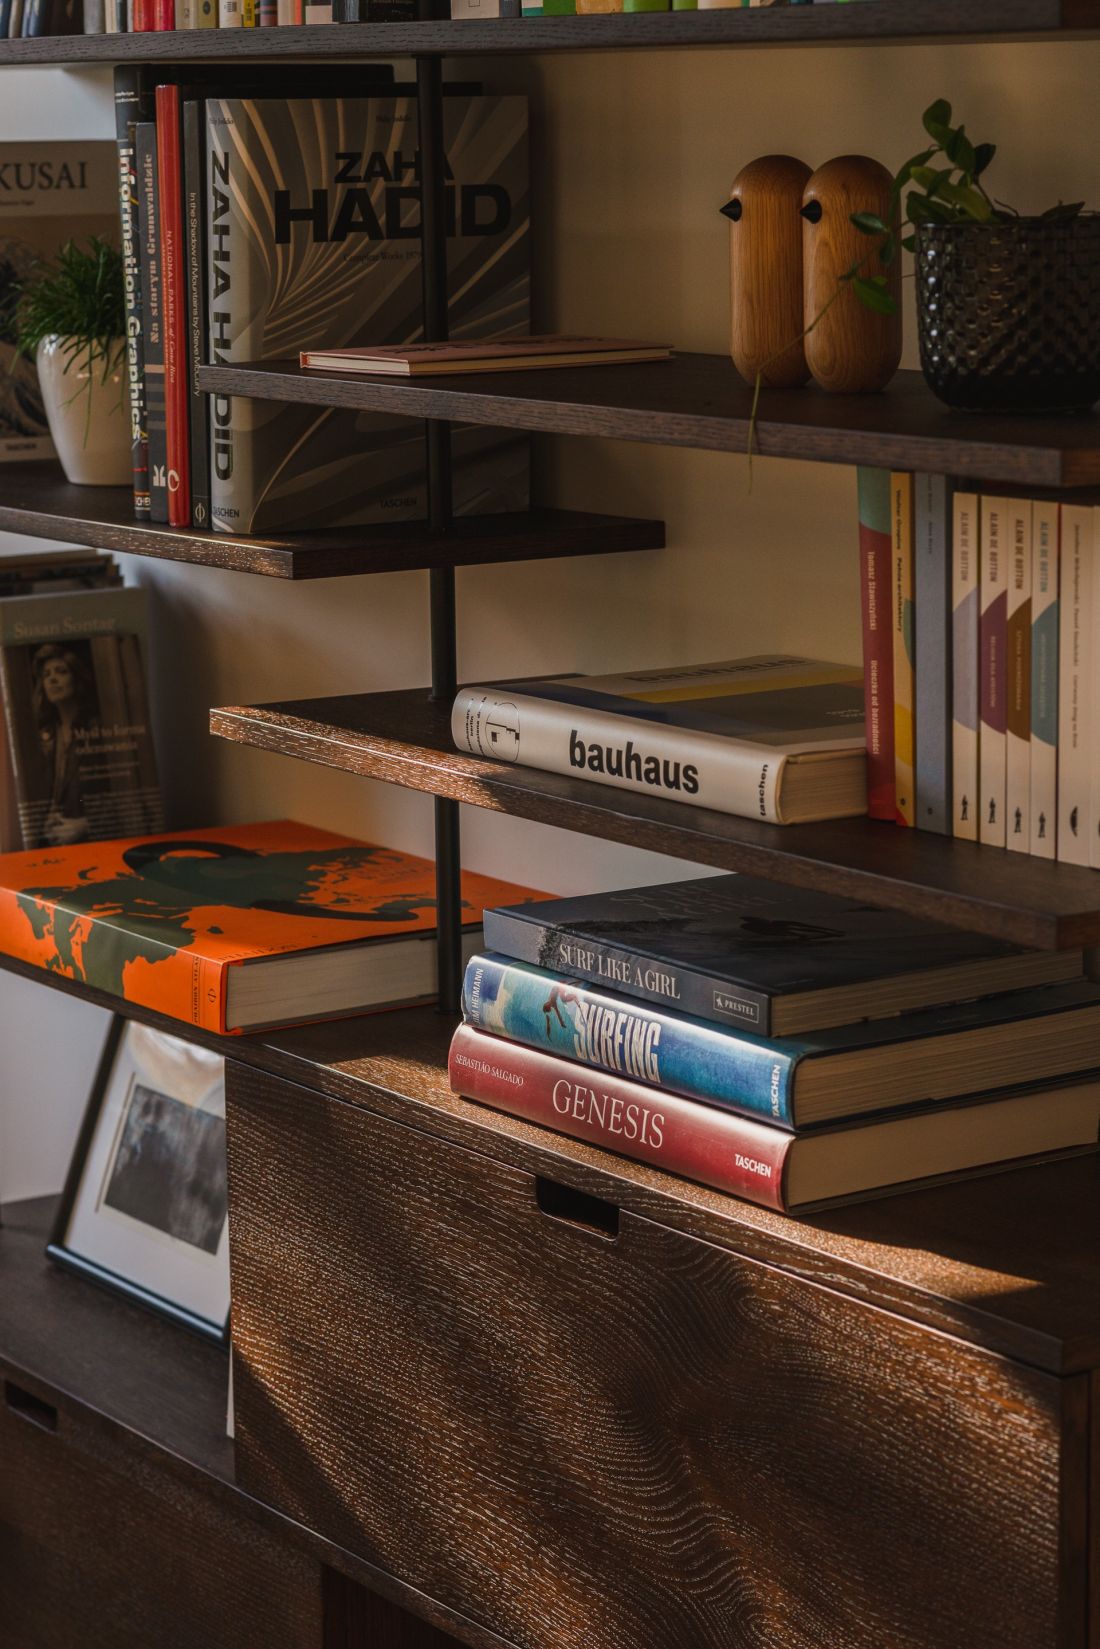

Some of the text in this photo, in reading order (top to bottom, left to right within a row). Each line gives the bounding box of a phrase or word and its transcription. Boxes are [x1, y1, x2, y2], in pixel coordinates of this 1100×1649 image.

[190, 192, 197, 202] In
[191, 218, 199, 256] Shadow
[212, 151, 232, 299] ZAHA
[166, 230, 174, 285] NATIONAL
[192, 257, 199, 267] of
[168, 289, 176, 324] PARKS
[192, 268, 200, 316] Mountains
[193, 317, 201, 328] by
[126, 316, 144, 439] Graphics
[194, 356, 202, 397] McCurry
[1015, 546, 1024, 556] DE
[872, 696, 880, 706] od
[569, 729, 700, 794] bauhaus
[757, 764, 769, 817] taschen
[471, 967, 485, 1009] HEIMANN
[559, 943, 681, 999] SURF LIKE A GIRL
[724, 998, 755, 1016] PRESTEL
[573, 1001, 662, 1083] SURFING
[490, 1064, 525, 1087] SALGADO
[771, 1064, 782, 1118] TASCHEN
[552, 1079, 665, 1149] GENESIS
[734, 1153, 772, 1178] TASCHEN
